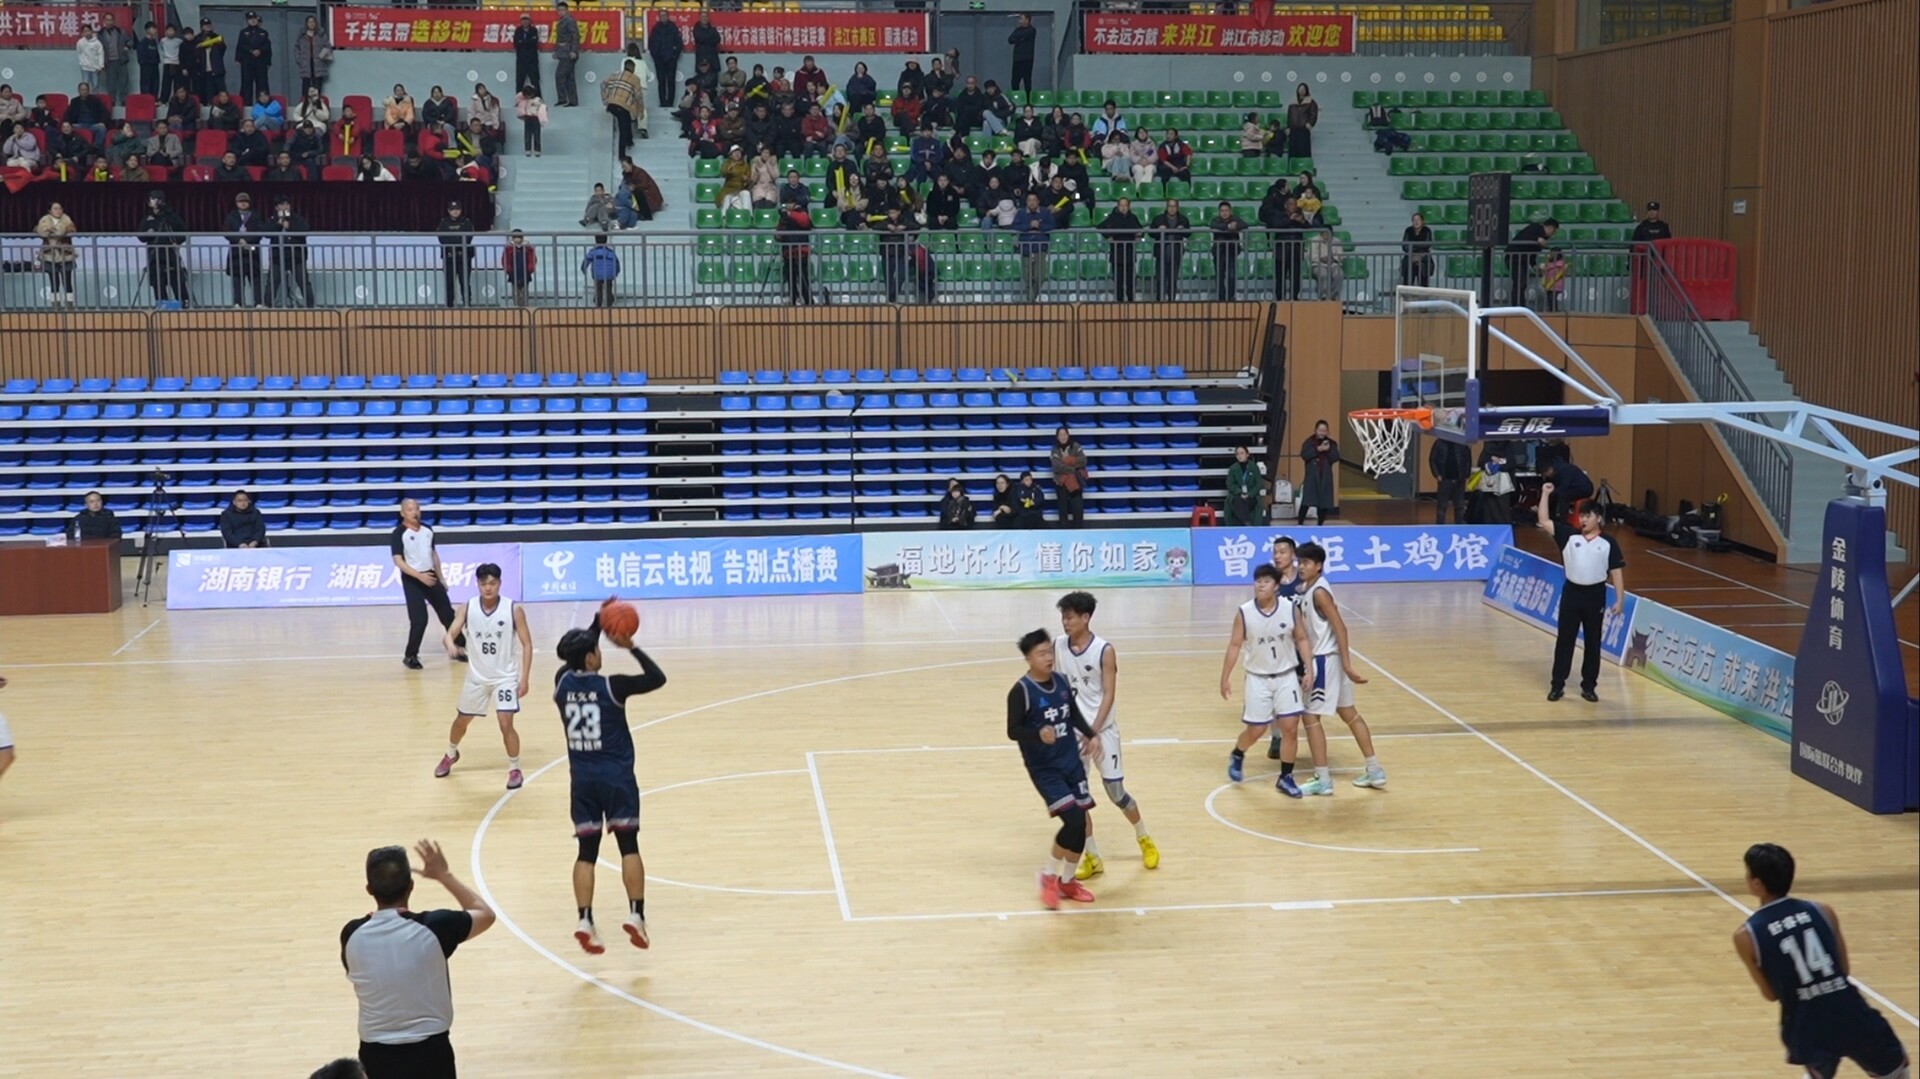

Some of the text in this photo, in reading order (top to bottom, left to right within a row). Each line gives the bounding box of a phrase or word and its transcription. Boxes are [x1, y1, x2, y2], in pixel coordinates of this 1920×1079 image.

[1491, 416, 1561, 435] 金陵
[595, 546, 838, 588] 电信云电视 告别点播费
[897, 540, 1159, 575] 福地怀化 懂你如家
[1218, 532, 1490, 578] 曾柜土鸡馆
[198, 562, 479, 592] 湖南银行 湖南人银行
[1828, 536, 1847, 651] 金陵体育
[482, 641, 497, 655] 66
[1271, 646, 1277, 660] 1
[1645, 622, 1717, 683] 不去远方
[498, 689, 513, 702] 66
[1292, 689, 1298, 703] 1
[565, 703, 602, 740] 23
[1111, 754, 1119, 770] 7
[1779, 926, 1836, 985] 14
